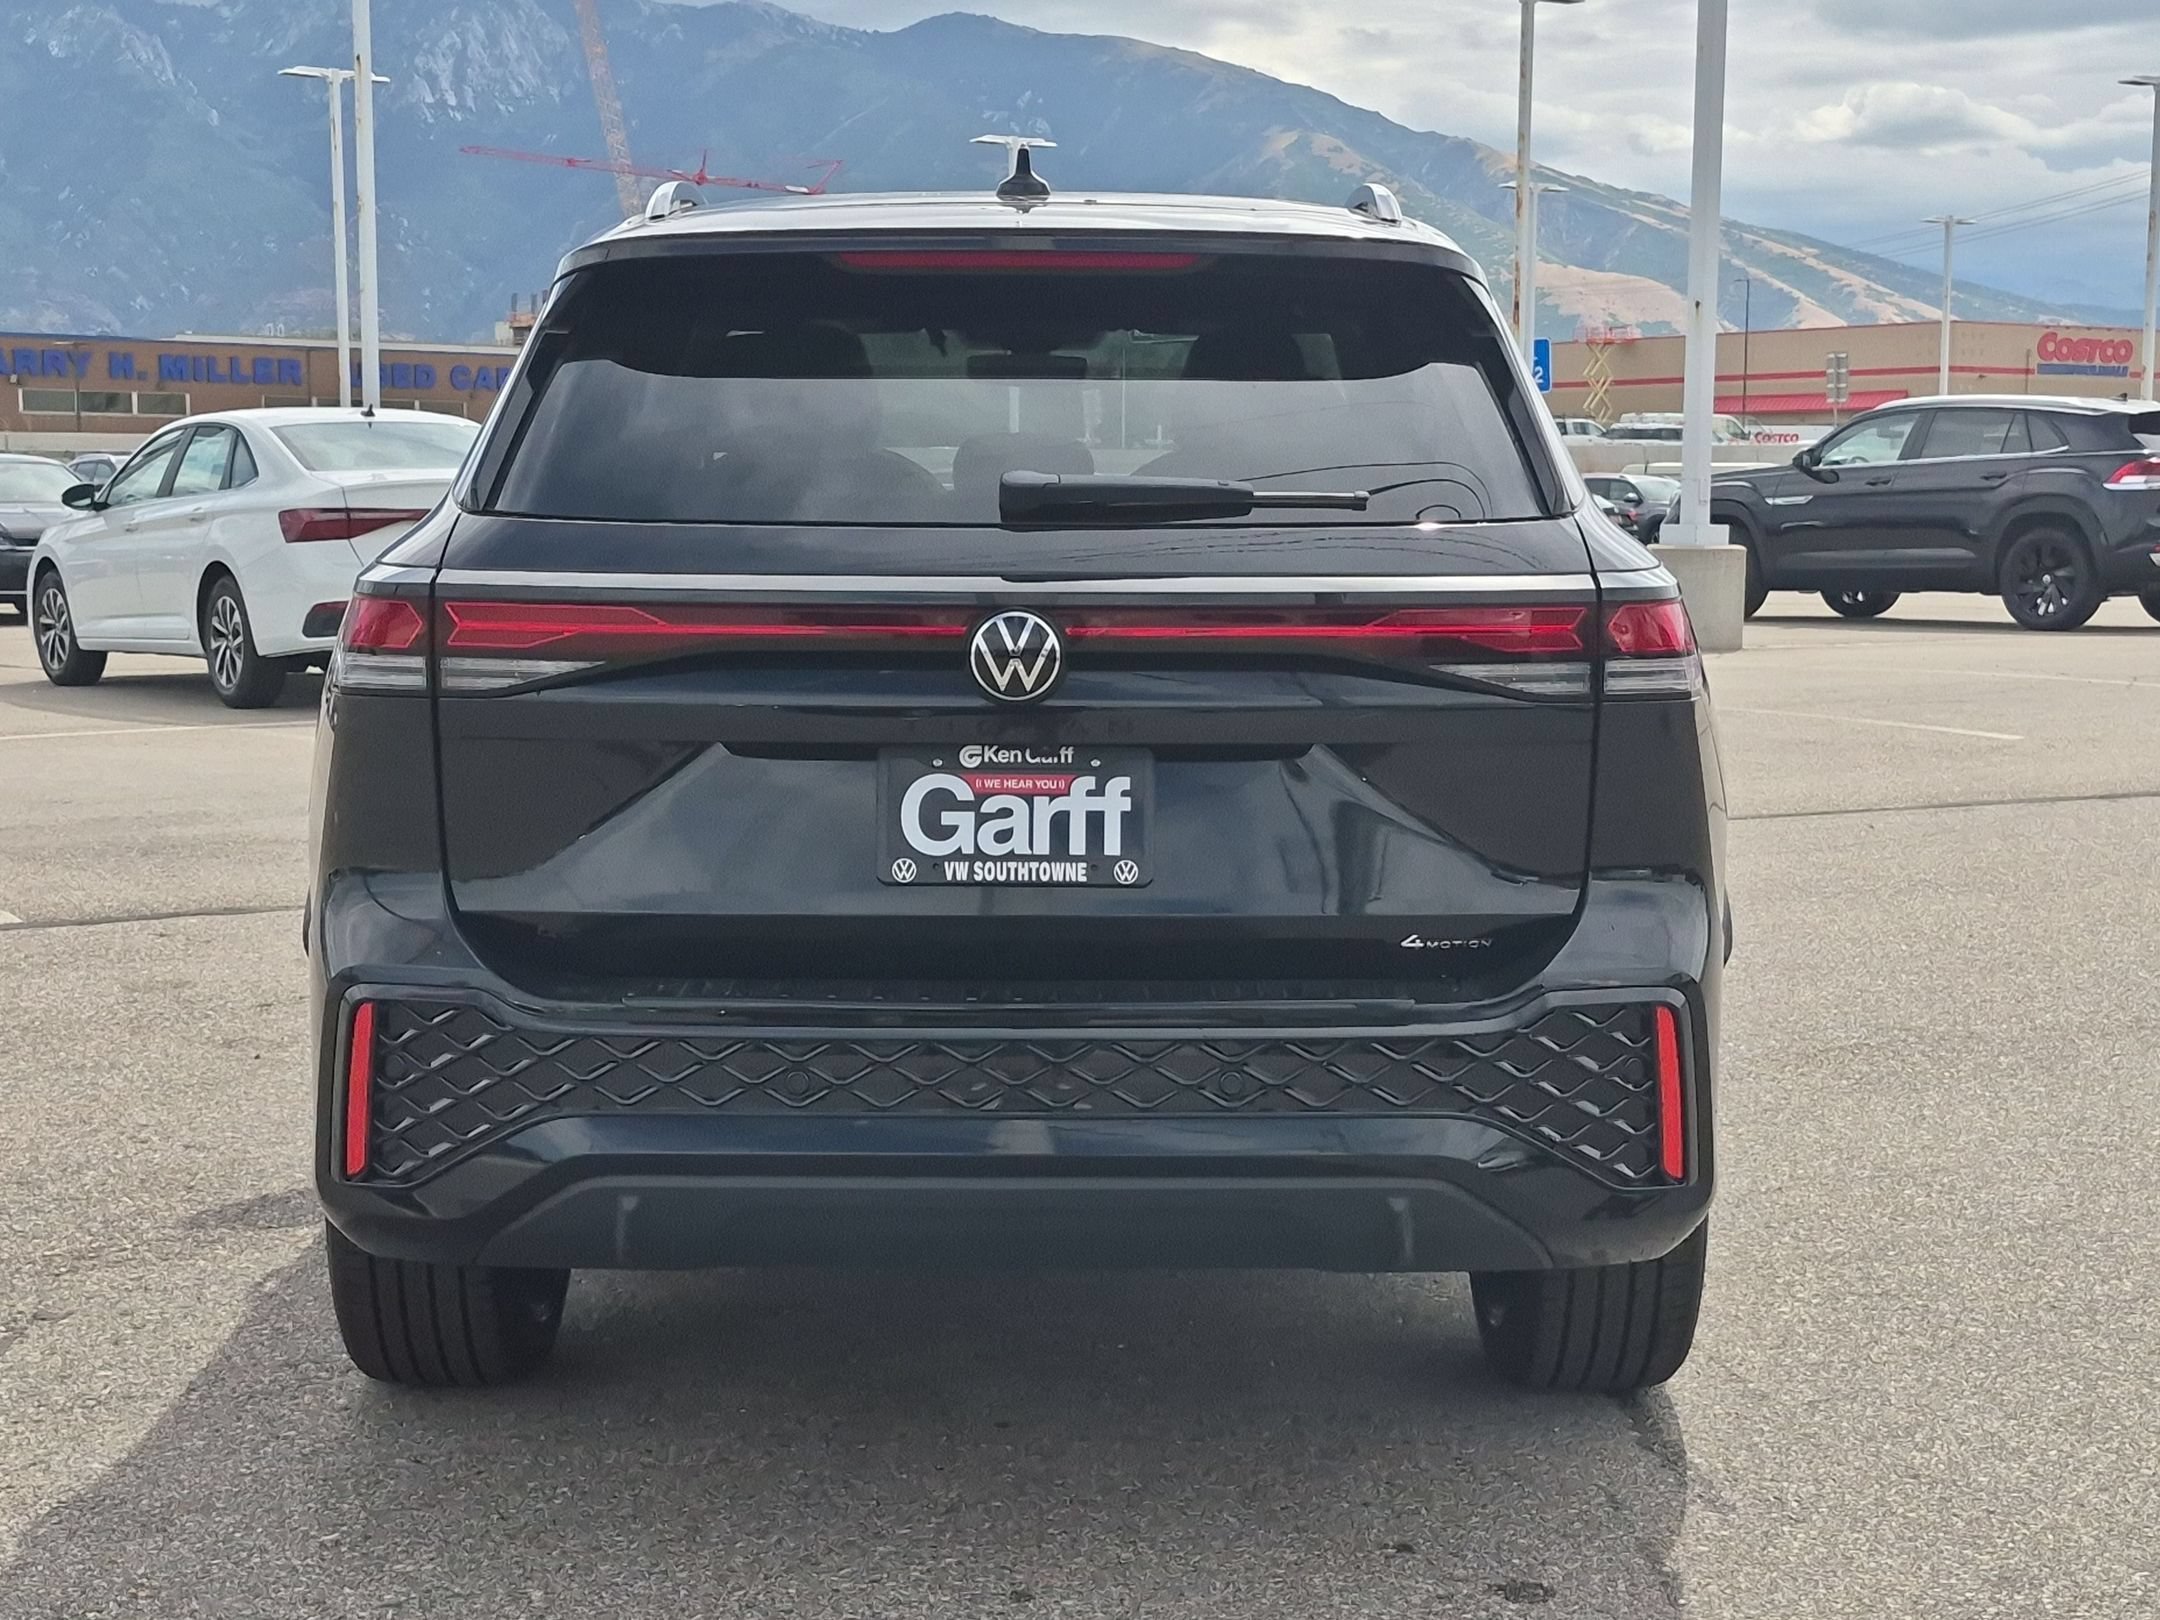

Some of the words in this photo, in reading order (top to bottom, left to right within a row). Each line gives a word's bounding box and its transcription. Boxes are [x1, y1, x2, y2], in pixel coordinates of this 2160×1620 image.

[158, 353, 302, 385] MILLER
[1754, 431, 1800, 444] COSTCO
[983, 745, 1022, 763] Ken
[984, 779, 1001, 789] WE
[1003, 779, 1033, 789] HEAR
[1035, 779, 1057, 789] YOU
[900, 773, 1132, 857] Garff
[944, 861, 969, 881] VW
[973, 861, 1088, 882] SOUTHTOWNE
[1400, 934, 1492, 950] 4MOTION
